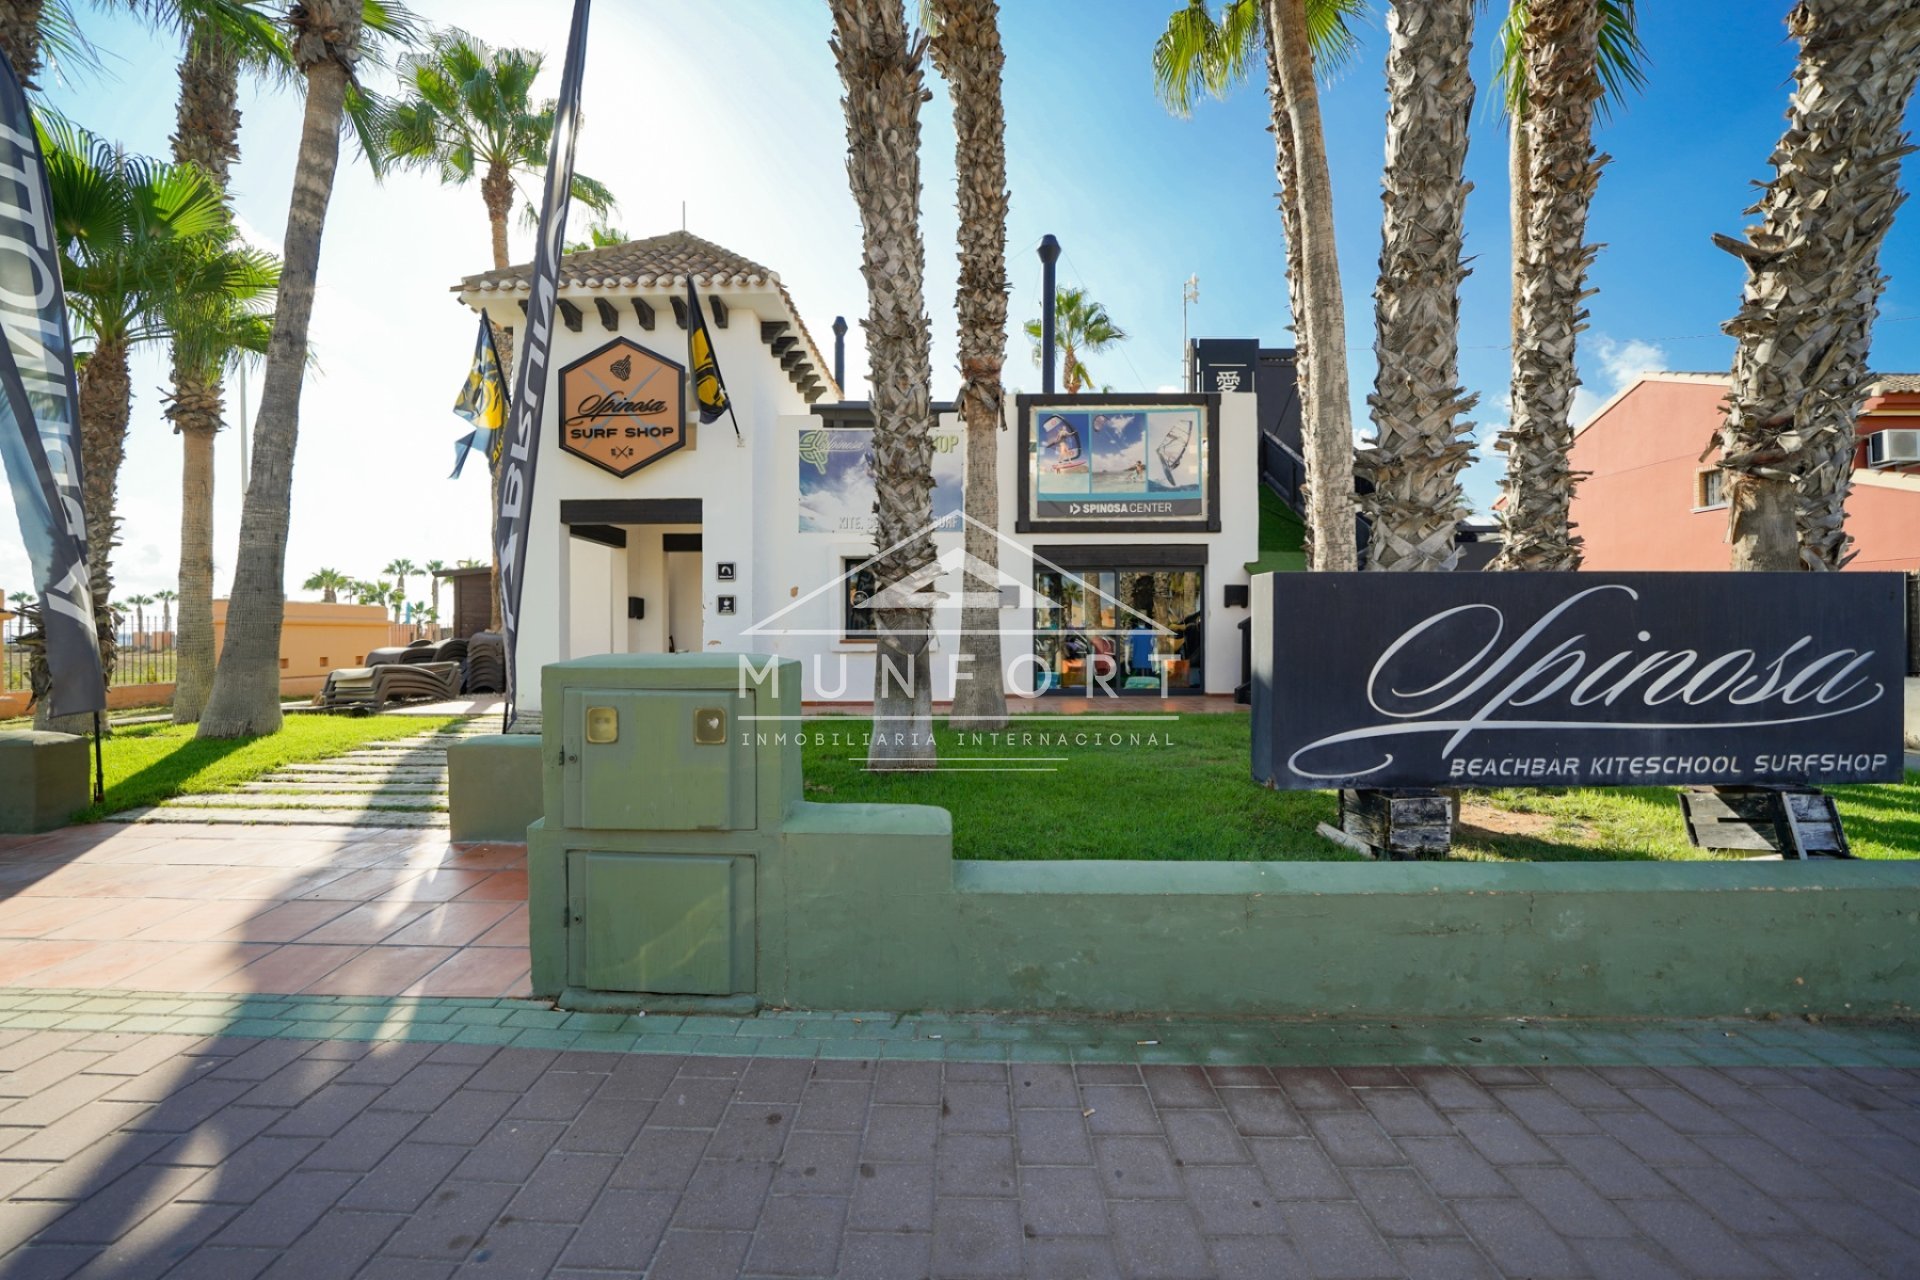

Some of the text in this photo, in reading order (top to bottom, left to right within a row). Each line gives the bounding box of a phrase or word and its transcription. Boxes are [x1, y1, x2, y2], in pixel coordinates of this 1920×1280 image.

[565, 390, 668, 426] Spinosa
[570, 427, 674, 439] SURF SHOP
[1082, 502, 1172, 514] SPINOSA CENTER
[1288, 585, 1885, 779] Spinosa
[1450, 753, 1888, 777] BEACHBAR KITESCHOOL SURFSHOP
